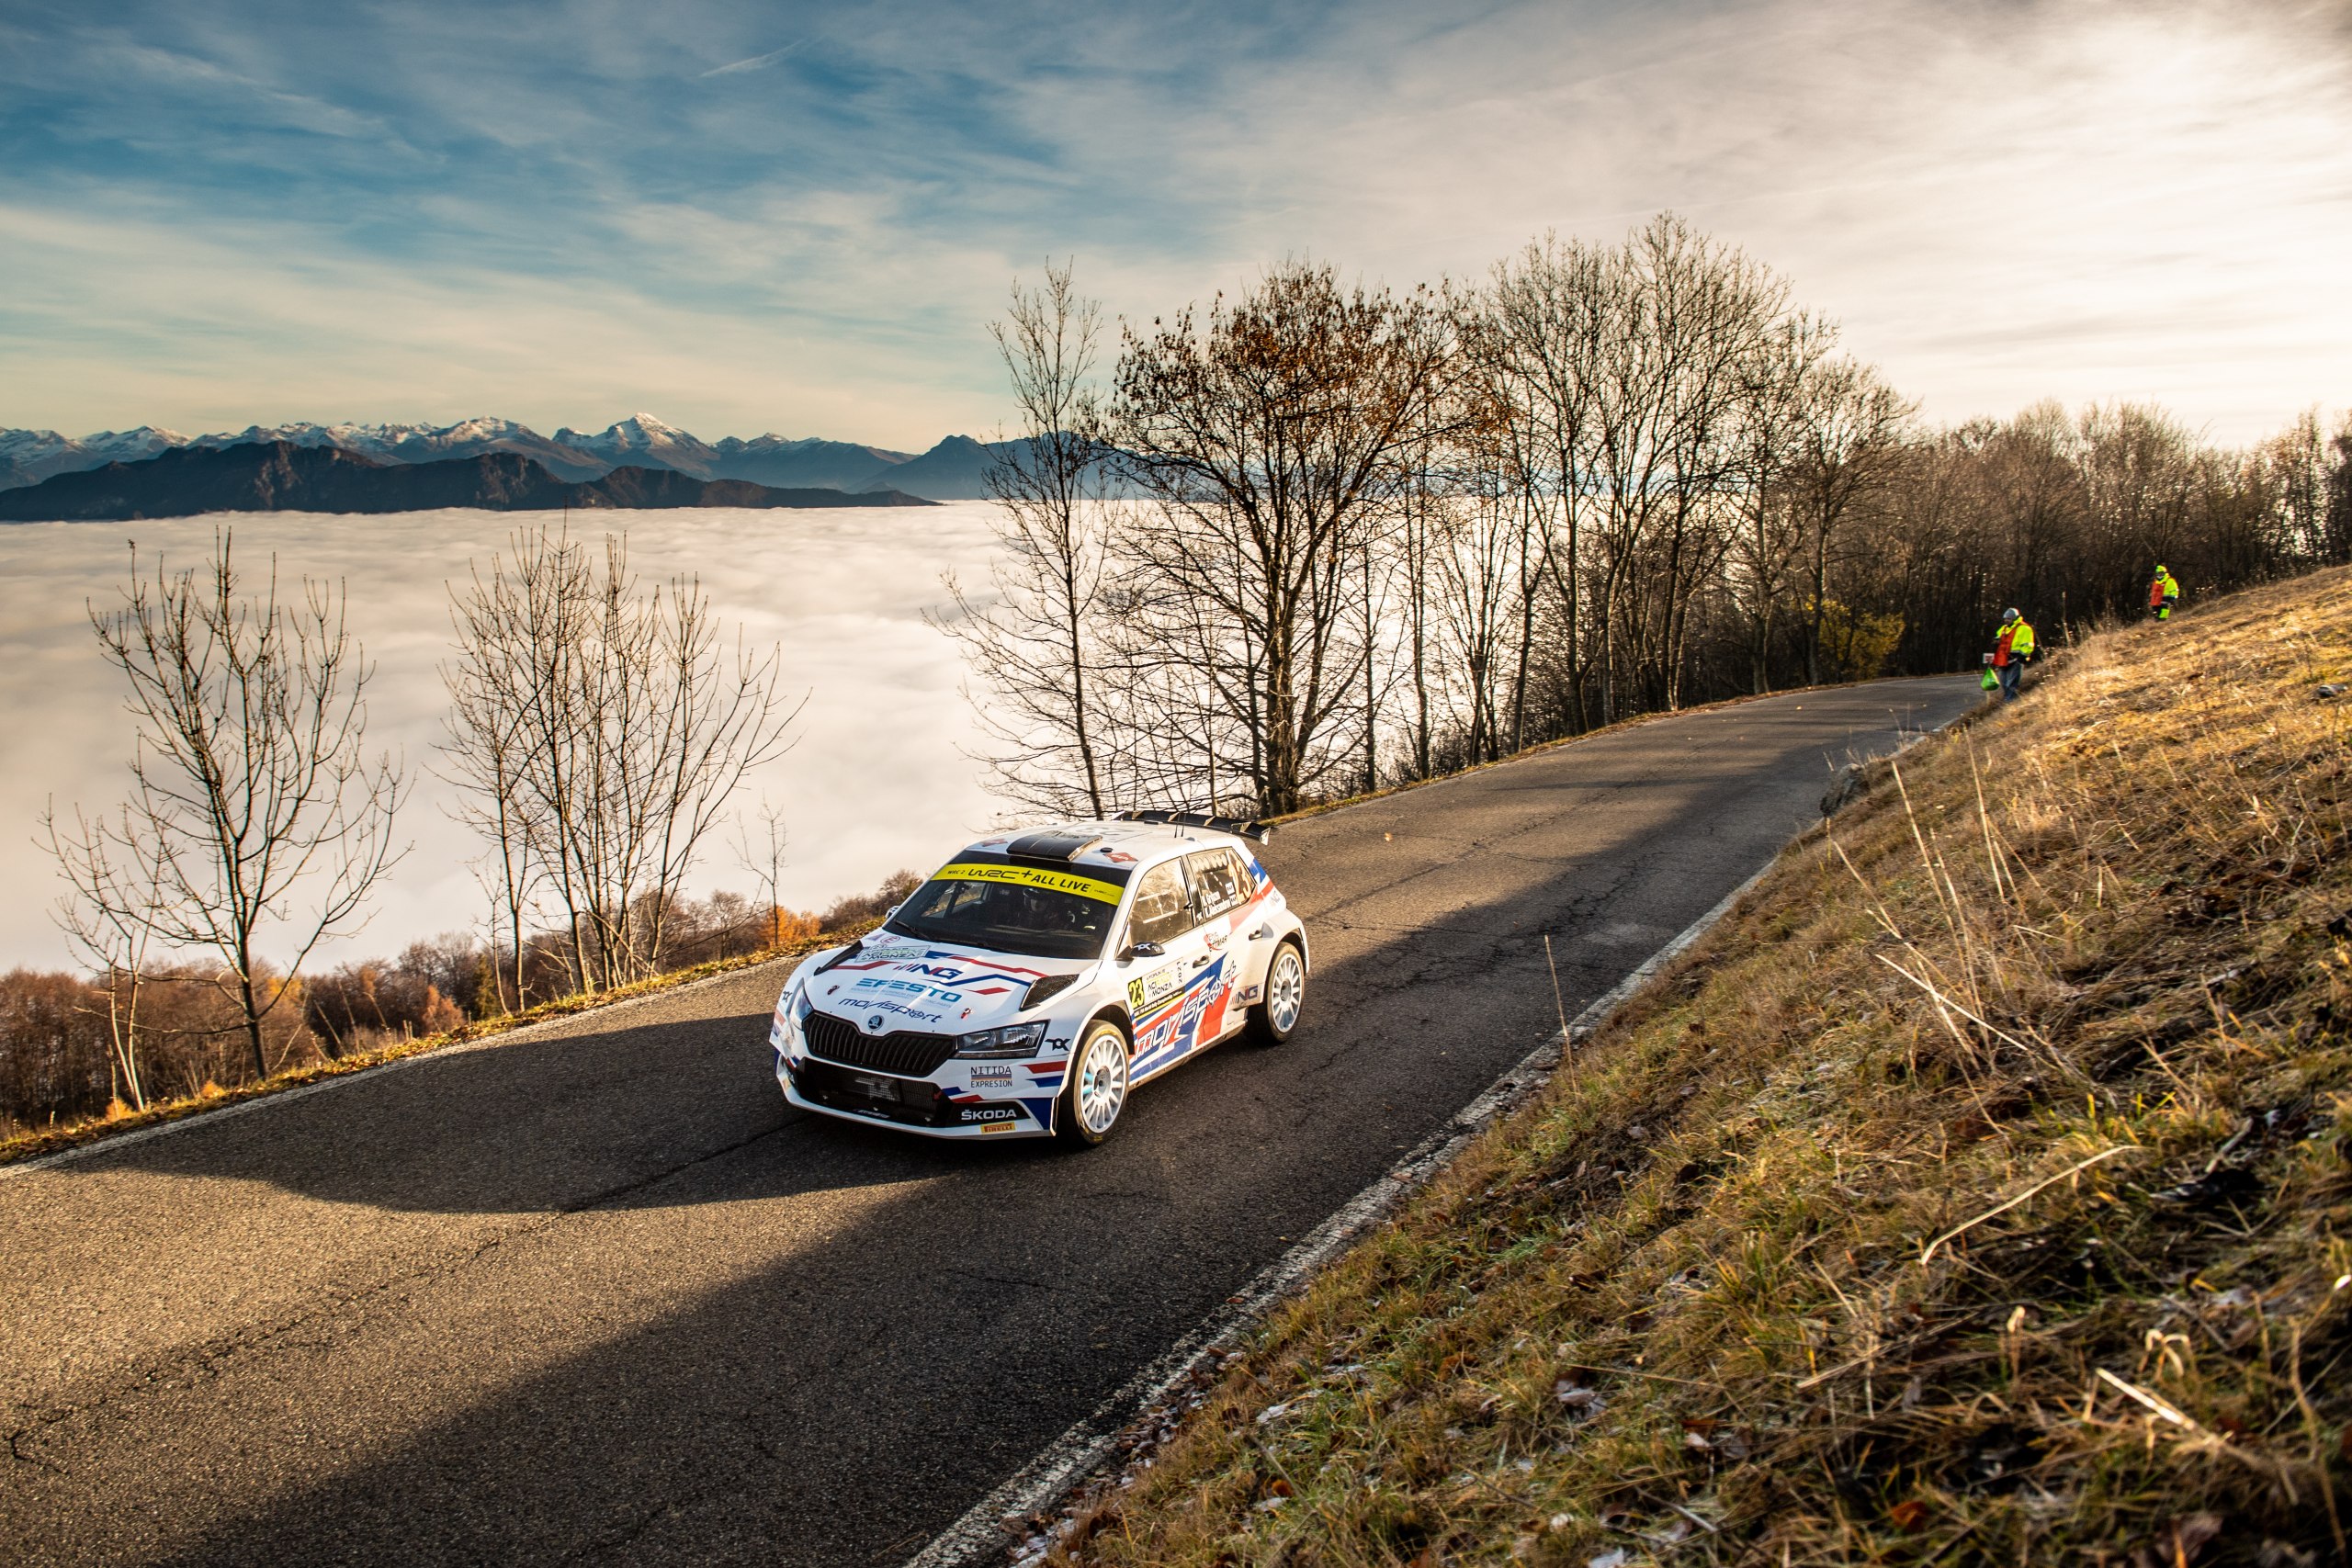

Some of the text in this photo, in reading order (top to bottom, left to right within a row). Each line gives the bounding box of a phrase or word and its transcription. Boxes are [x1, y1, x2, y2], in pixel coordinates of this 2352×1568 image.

[1031, 874, 1056, 886] ALL
[1059, 878, 1091, 893] LIVE
[855, 977, 963, 1002] EFESTO
[1128, 978, 1145, 1010] 23
[1151, 982, 1173, 998] MONZA
[970, 1066, 1012, 1075] NITIDA
[970, 1079, 1012, 1089] EXPRESION
[960, 1109, 1018, 1121] ŠKODA
[984, 1122, 1013, 1133] PIRELLI
